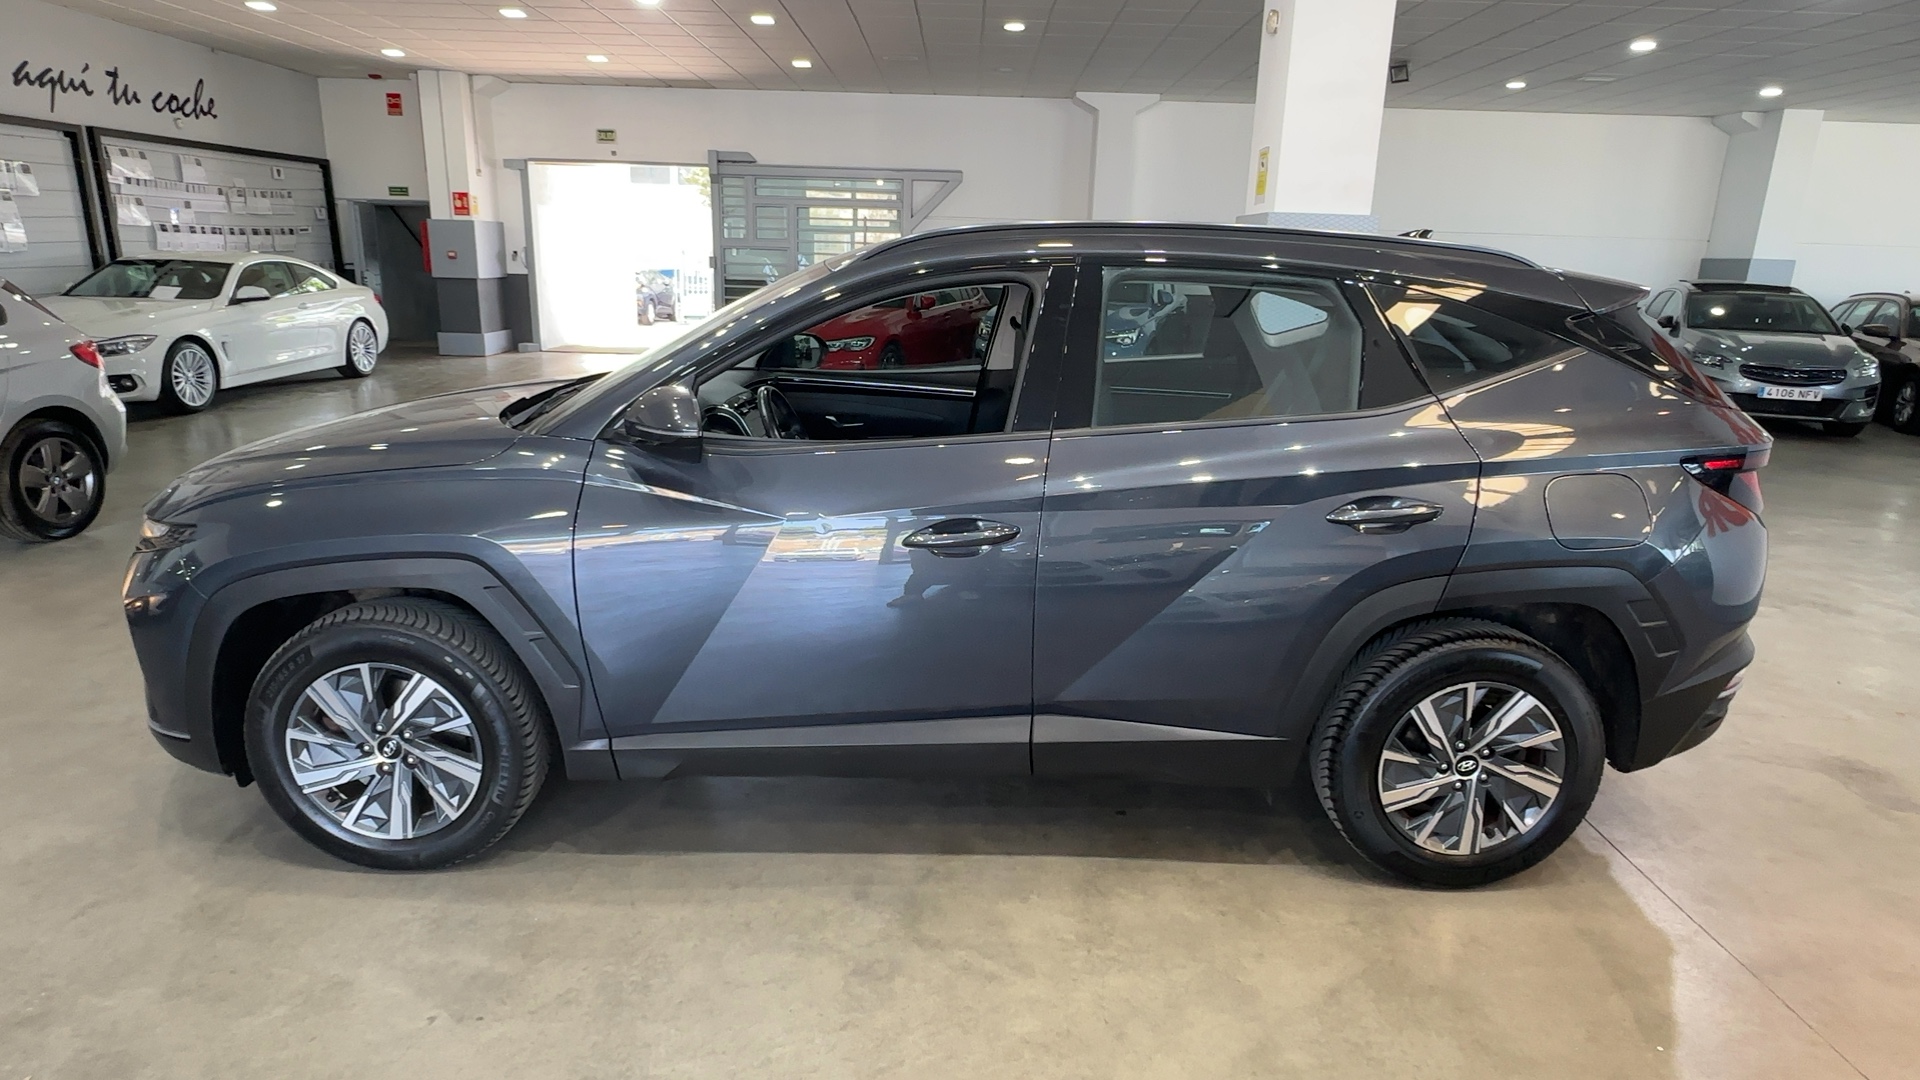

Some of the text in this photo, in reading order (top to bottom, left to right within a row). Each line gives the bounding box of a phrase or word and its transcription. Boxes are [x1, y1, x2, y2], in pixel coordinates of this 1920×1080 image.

[12, 60, 218, 119] aquí tu coche
[1767, 388, 1820, 399] 4106 NFV
